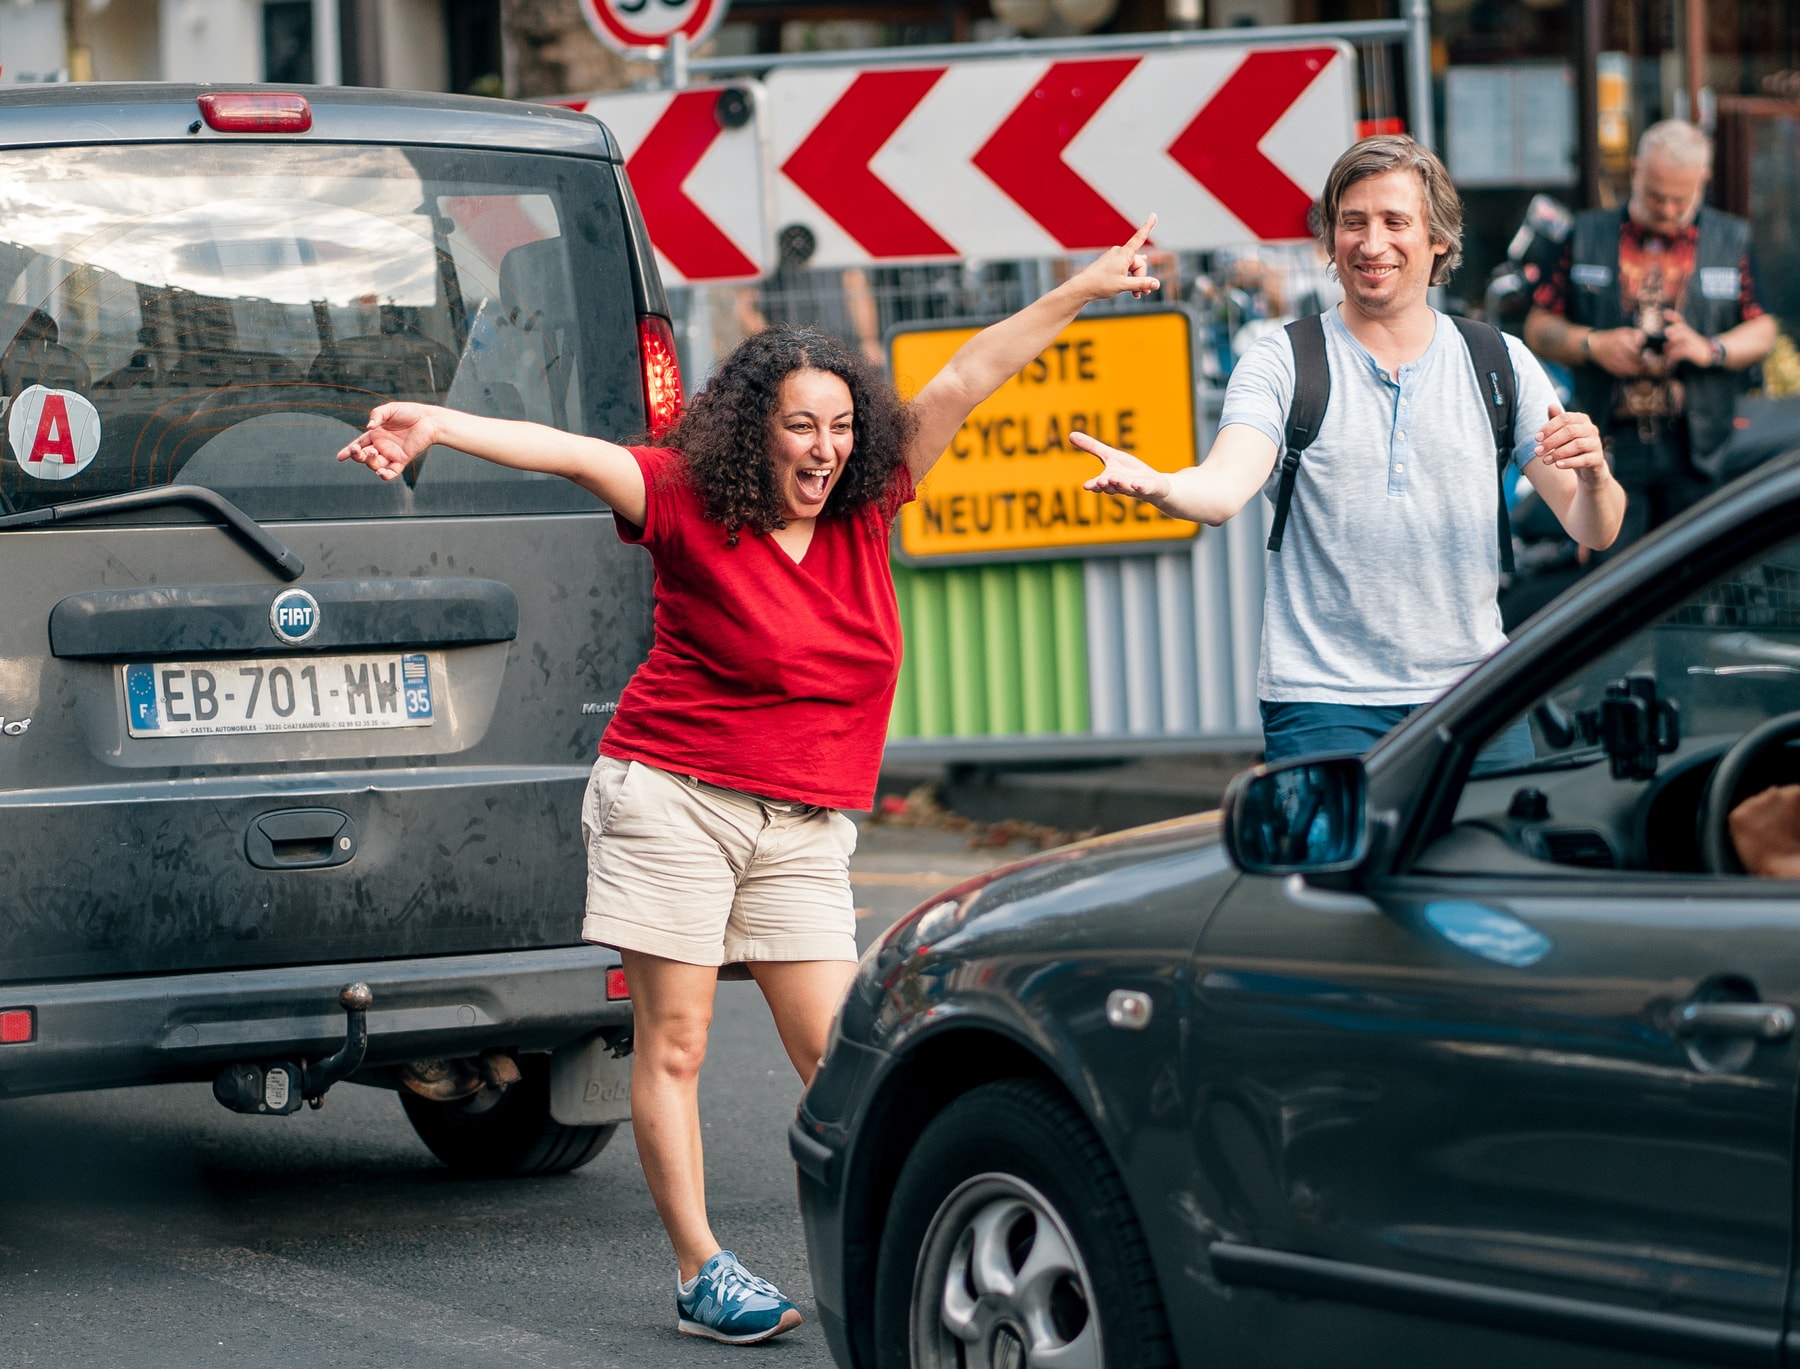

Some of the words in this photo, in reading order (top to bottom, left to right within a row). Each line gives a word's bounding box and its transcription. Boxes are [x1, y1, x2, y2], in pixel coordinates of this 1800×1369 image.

[1017, 341, 1095, 386] STE
[28, 394, 76, 464] A
[951, 409, 1136, 459] CYCLABLE
[923, 486, 1176, 536] NEUTRALISE
[279, 607, 312, 626] FIAT
[139, 703, 148, 718] F
[162, 662, 398, 722] EB-701-MW
[406, 689, 430, 714] 35
[191, 726, 213, 734] CASTEL
[215, 724, 257, 733] AUTOMOBILES
